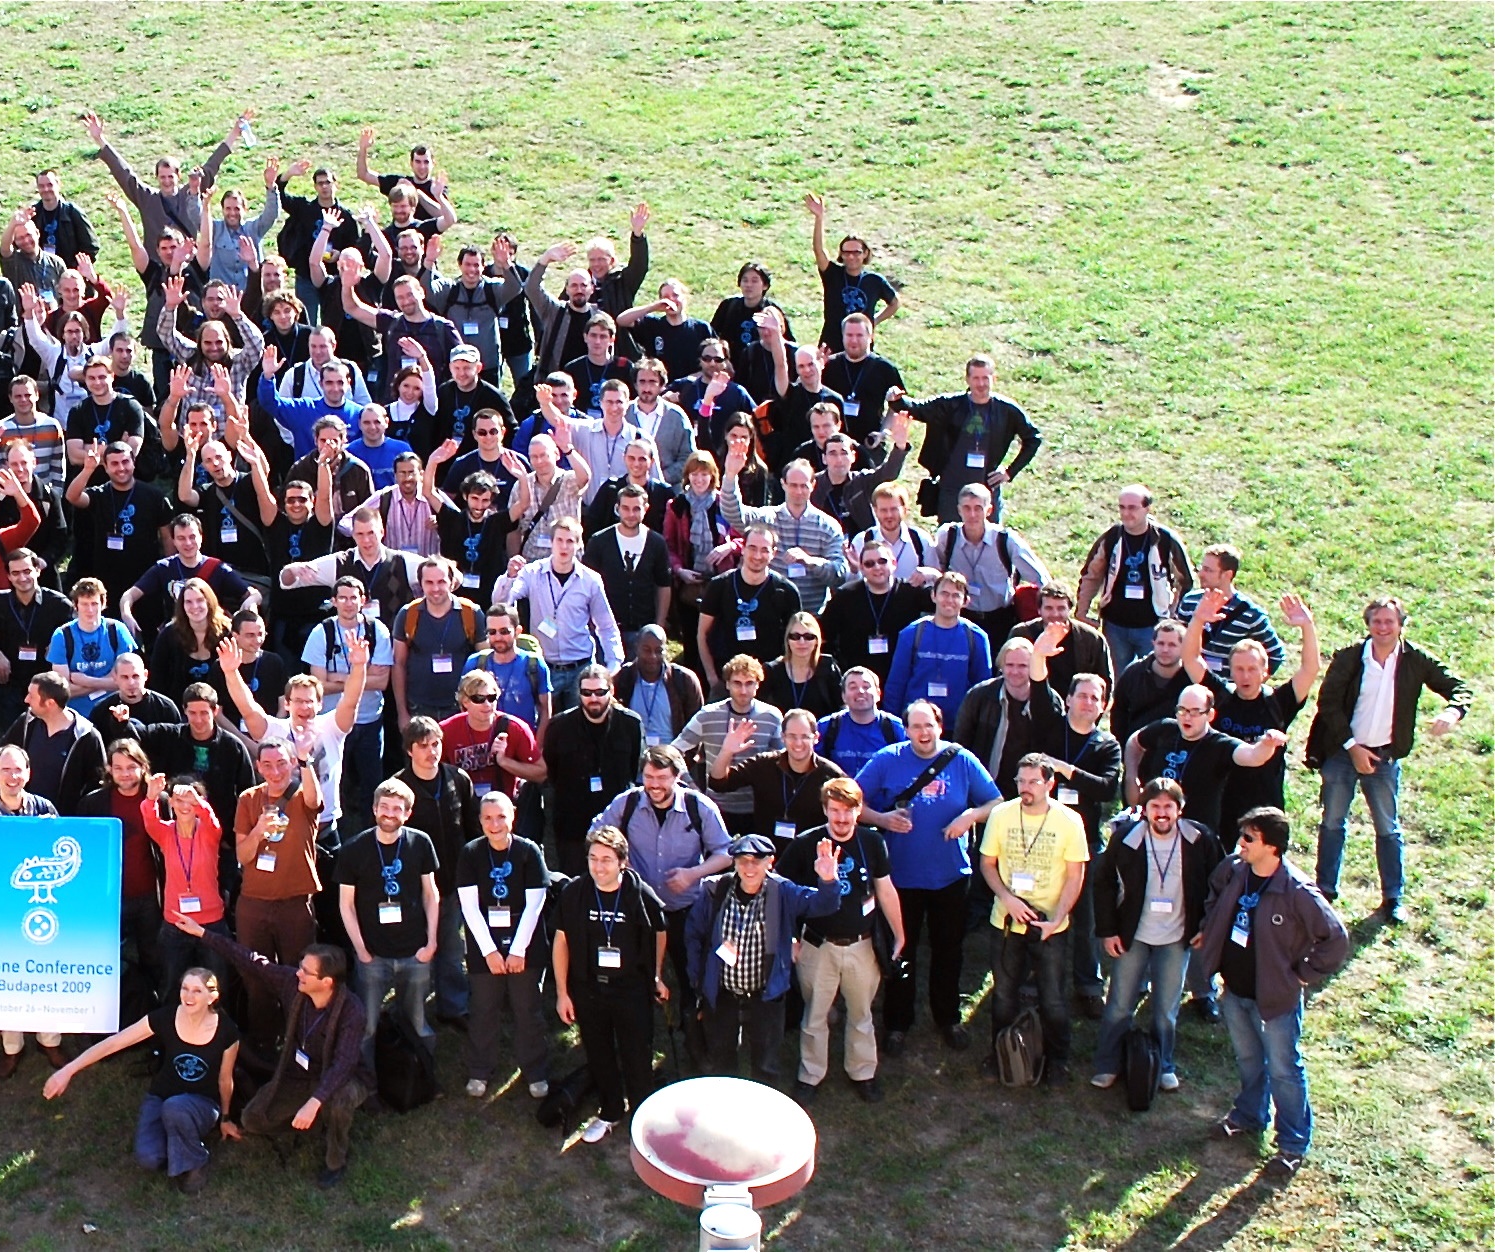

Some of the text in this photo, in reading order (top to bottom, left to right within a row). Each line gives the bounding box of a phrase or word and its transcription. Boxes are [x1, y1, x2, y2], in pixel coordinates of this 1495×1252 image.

[25, 959, 113, 975] Conference
[61, 981, 92, 993] 2009
[43, 1005, 89, 1015] November
